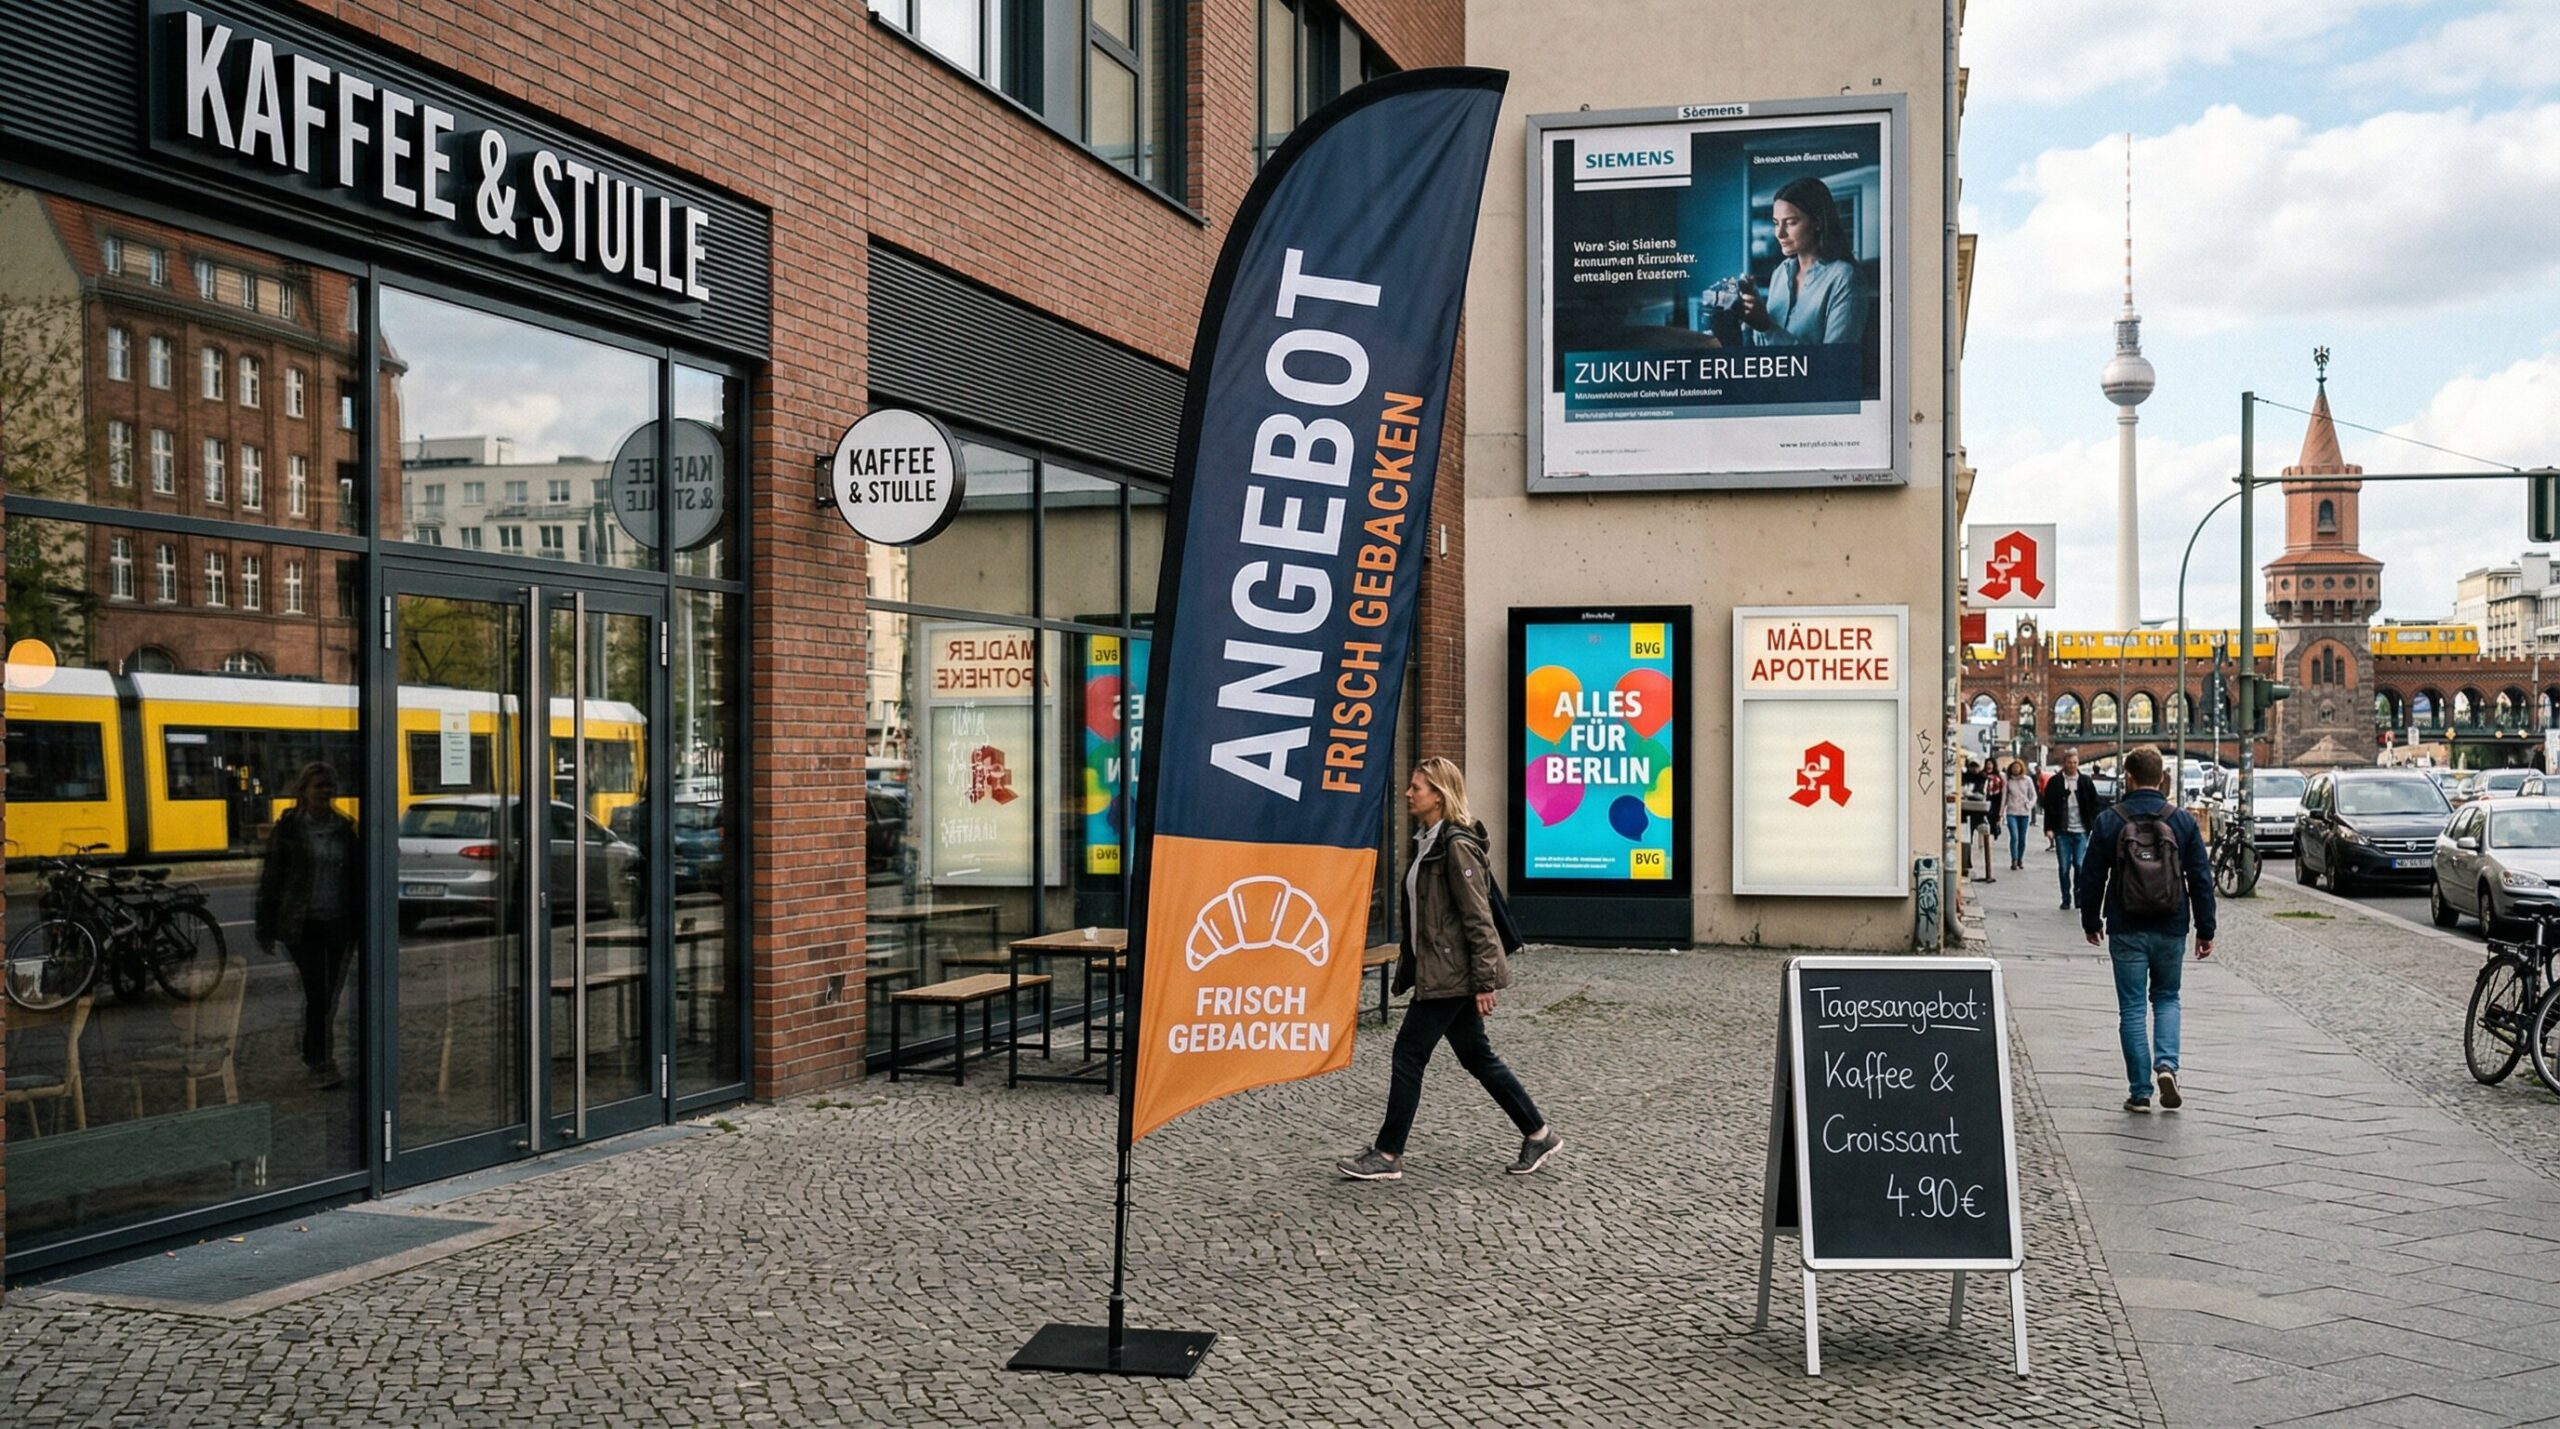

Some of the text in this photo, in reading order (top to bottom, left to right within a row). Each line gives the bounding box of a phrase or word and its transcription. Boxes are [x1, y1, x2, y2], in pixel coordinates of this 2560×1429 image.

[187, 12, 710, 302] KAFFEE & STULLE
[1585, 150, 1675, 169] SIEMENS
[1574, 355, 1808, 384] ZUKUNFT ERLEBEN
[849, 446, 936, 476] KAFFEE
[848, 479, 937, 504] & STULLE
[1210, 248, 1382, 801] ANGEBOT
[1322, 391, 1424, 793] FRISCH GEBACKEN
[1635, 642, 1661, 655] BVG
[1767, 622, 1873, 651] MÄDLER
[1751, 658, 1890, 681] APOTHEKE
[1552, 690, 1643, 718] ALLES
[1571, 718, 1627, 752] FÜR
[1546, 757, 1650, 785] BERLIN
[1635, 853, 1661, 865] BVG
[1196, 985, 1307, 1016] FRISCH
[1809, 986, 1987, 1034] Tagesangebot:
[1168, 1021, 1330, 1054] GEBACKEN
[1824, 1051, 1955, 1099] Kaffee &
[1822, 1114, 1962, 1155] Croissant
[1886, 1173, 1987, 1218] 4.90€
